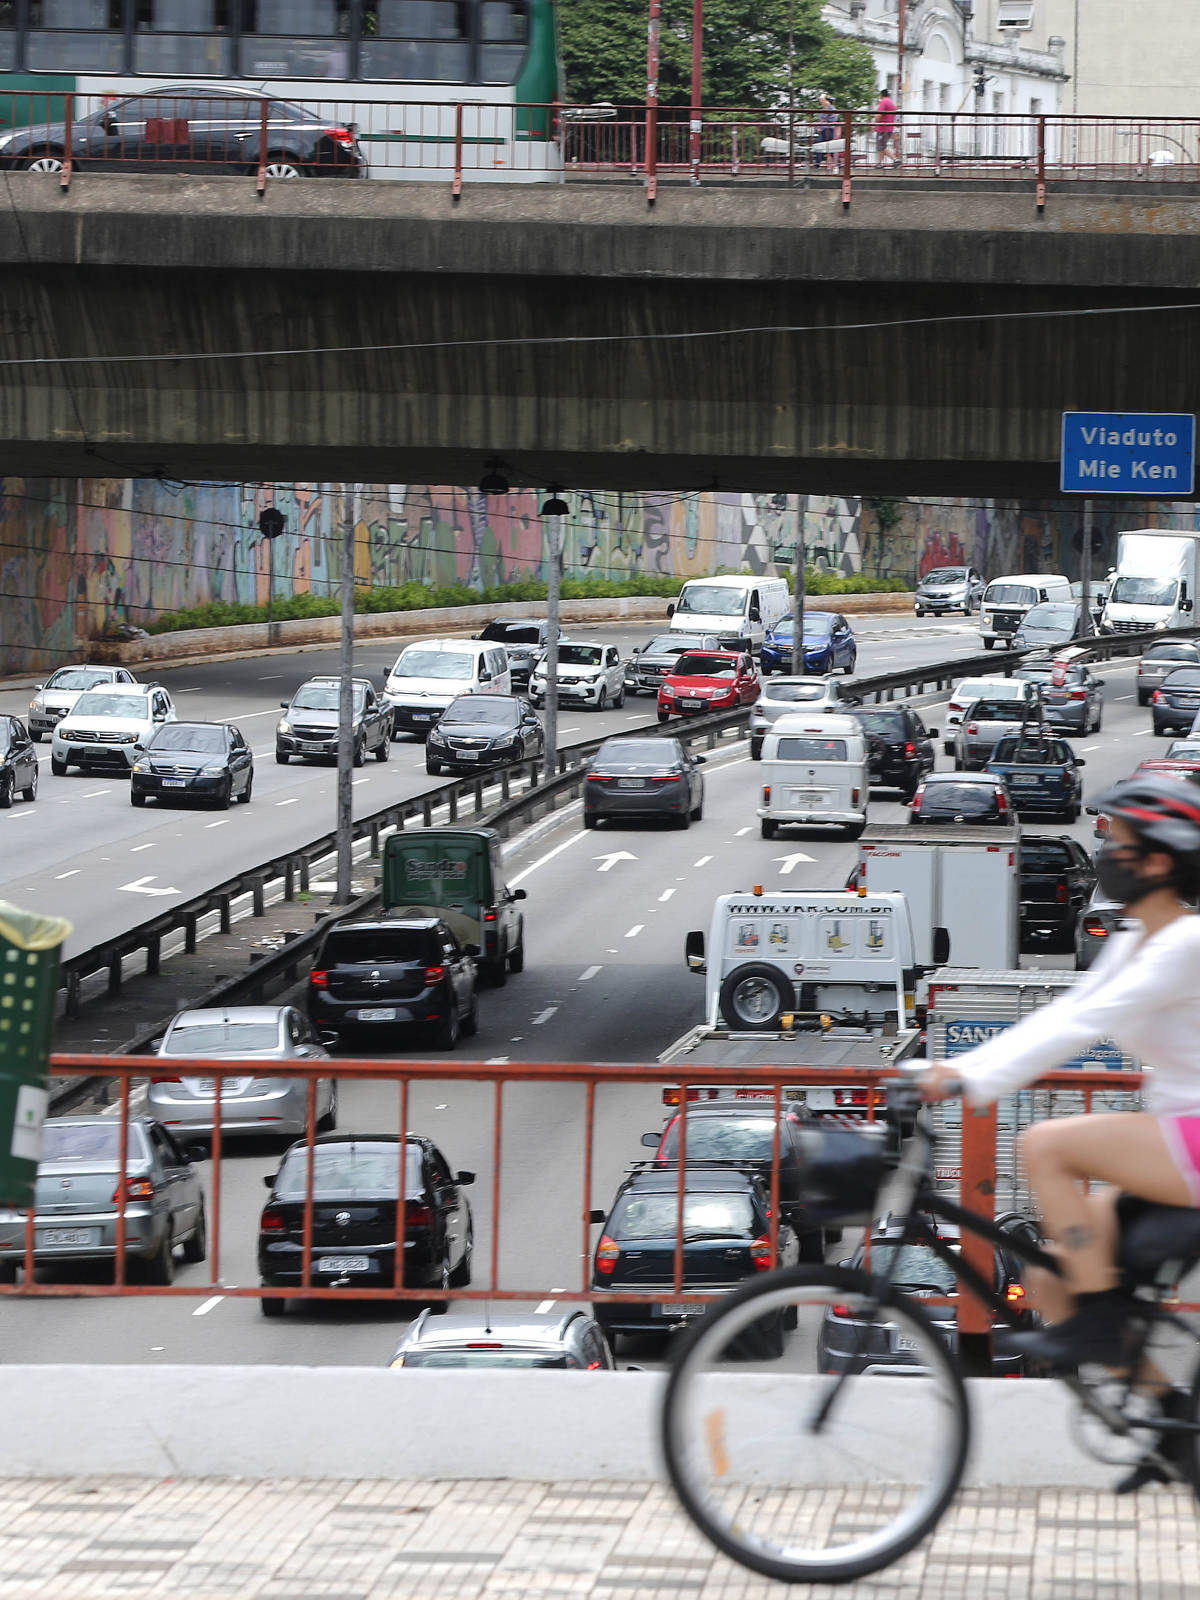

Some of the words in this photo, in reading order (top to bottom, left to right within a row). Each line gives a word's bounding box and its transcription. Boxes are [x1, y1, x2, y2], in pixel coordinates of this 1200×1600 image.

[1080, 427, 1177, 446] Viaduto
[1079, 459, 1121, 478] Mie
[1131, 461, 1177, 479] Ken
